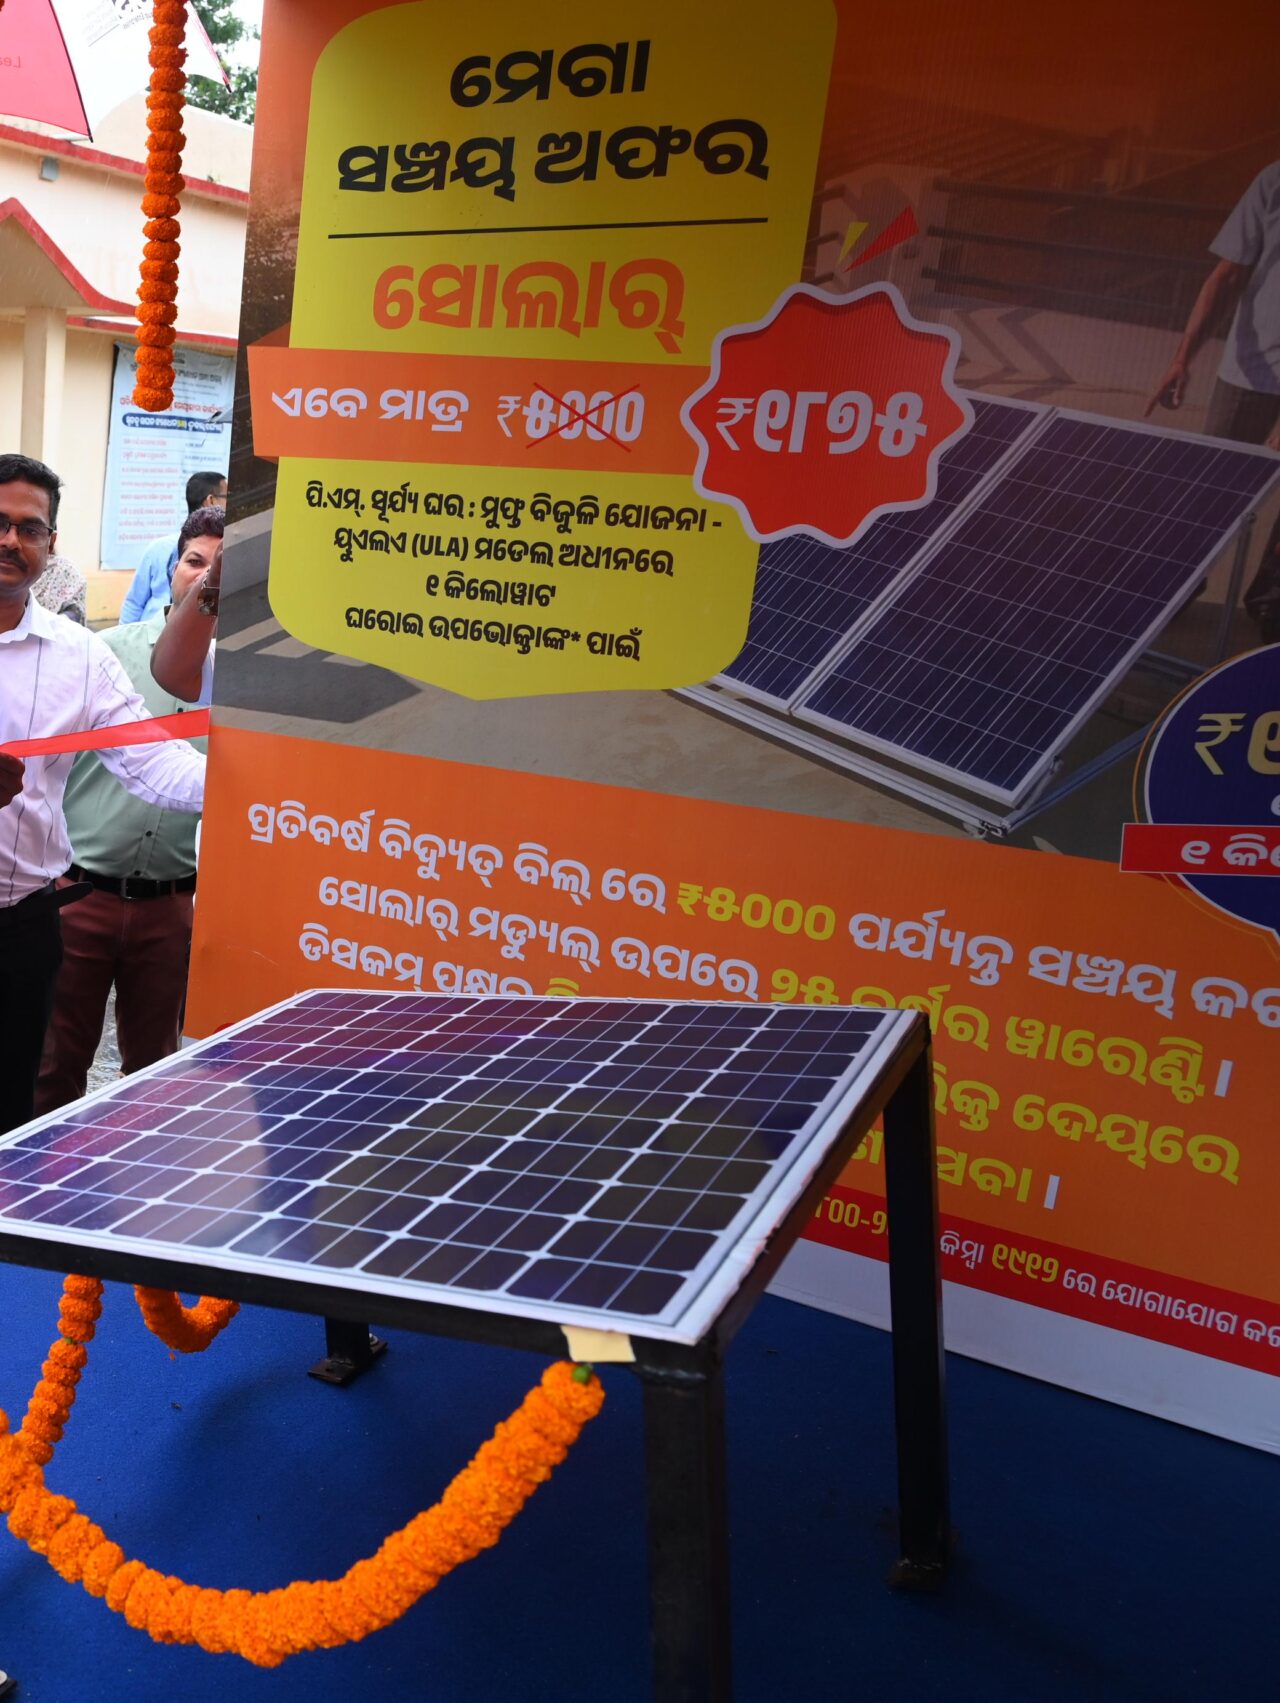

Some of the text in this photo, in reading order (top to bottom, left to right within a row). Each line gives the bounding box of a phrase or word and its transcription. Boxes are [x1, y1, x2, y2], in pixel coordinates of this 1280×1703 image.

[449, 39, 651, 108] ମେଗା
[337, 118, 769, 202] ସଞ୍ଚୟ ଅଫର
[371, 256, 686, 354] ସୋଲାର୍
[271, 387, 368, 419] ଏବେ
[378, 387, 470, 433] ମାତ୍ର
[715, 389, 928, 459] ₹୧୮୭୫
[423, 491, 465, 519] ଘର
[530, 492, 600, 534] ବିଜୁଳି
[604, 503, 707, 533] ଯୋଜନା
[333, 527, 407, 563] ୟୁଏଲଏ
[411, 535, 470, 561] (ULA)
[558, 544, 675, 577] ଅଧୀନରେ
[444, 570, 557, 607] କିଲୋୱାଟ
[344, 606, 425, 640] ଘରୋଇ
[586, 627, 643, 662] ପାଇଁ
[1193, 710, 1280, 776] ₹୧
[1222, 833, 1280, 868] କି
[247, 800, 1280, 1029] ପ୍ରତିବର୍ଷ ବିଦ୍ୟୁତ୍ ବିଲ୍ ରେ ₹୫୦୦୦ ପର୍ଯ୍ୟନ୍ତ ସଞ୍ଚୟ କର
[319, 875, 459, 940] ସୋଲାର୍
[610, 936, 760, 1001] ଉପରେ
[1013, 1094, 1240, 1187] ଦେୟରେ
[939, 1229, 986, 1271] କିମ୍ବା
[991, 1243, 1060, 1283] ୧୯୧୨
[1062, 1267, 1098, 1299] ରେ
[1101, 1278, 1239, 1336] ଯୋଗାଯୋଗ
